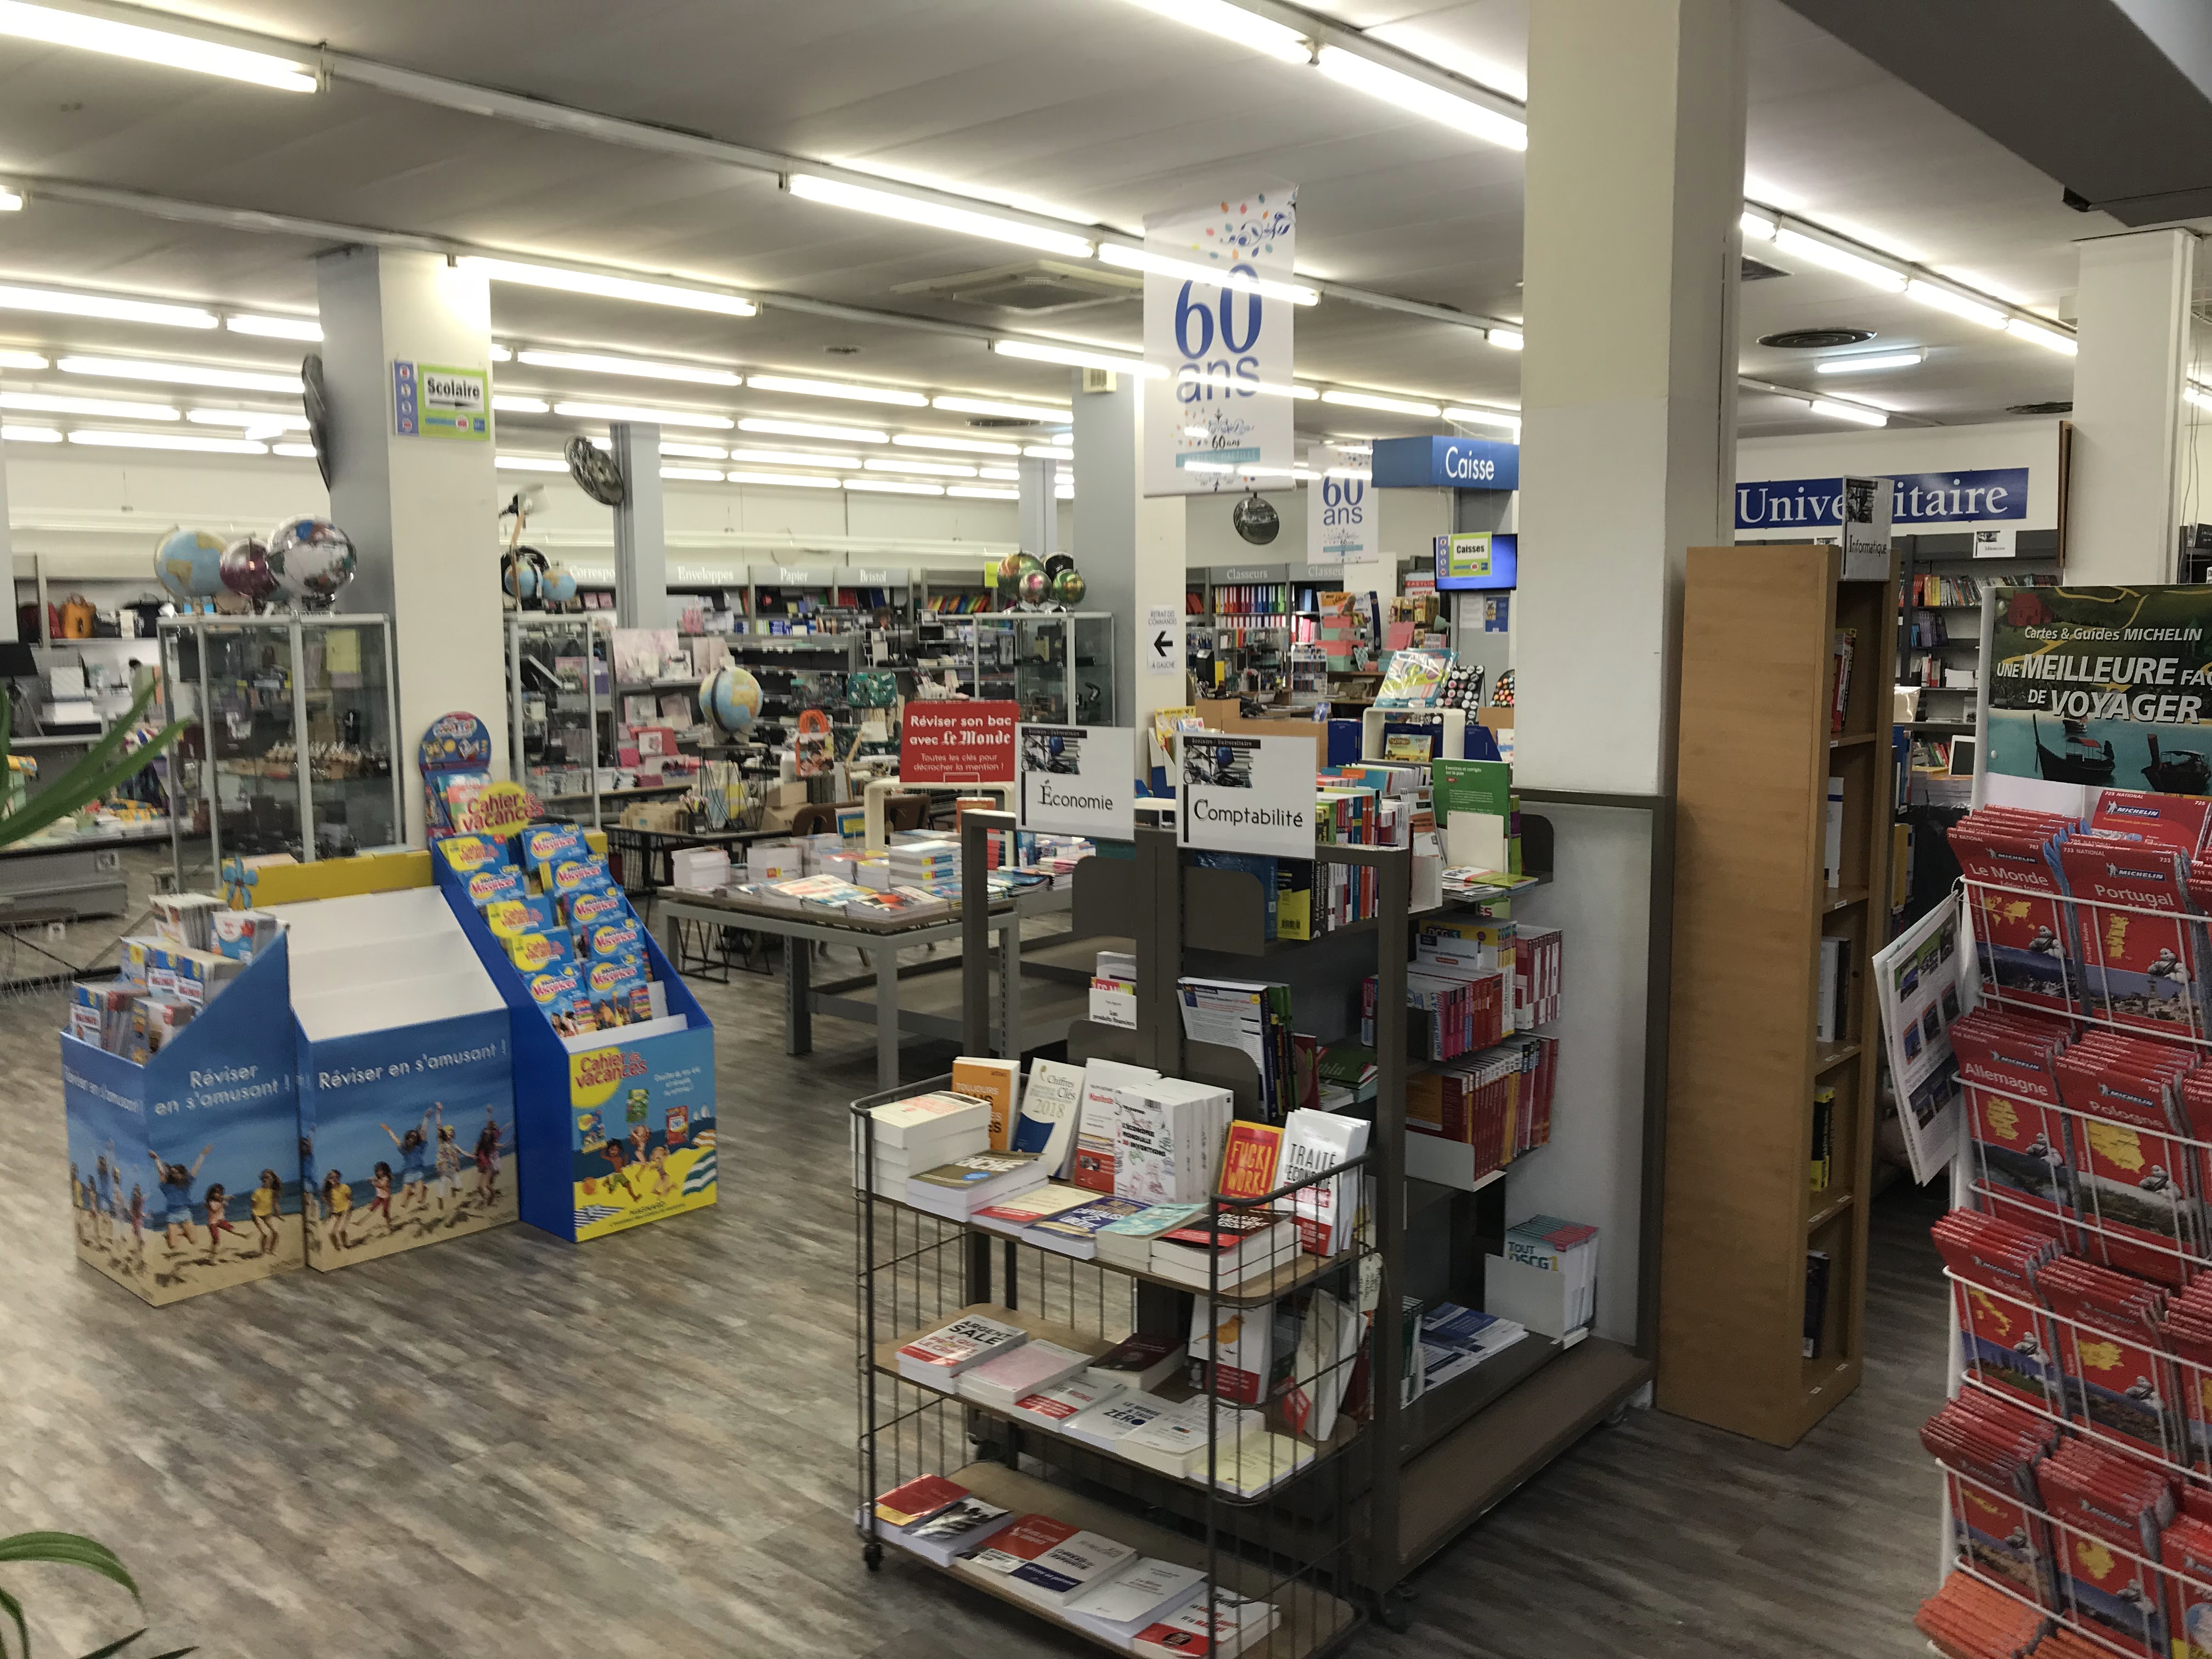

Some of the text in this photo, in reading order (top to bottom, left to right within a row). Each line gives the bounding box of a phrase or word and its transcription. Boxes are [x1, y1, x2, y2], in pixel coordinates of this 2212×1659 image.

[1175, 263, 1262, 359] 60
[427, 377, 480, 400] Scolaire
[1176, 356, 1260, 404] ans
[1212, 435, 1226, 449] 60
[1445, 445, 1495, 481] Caisse
[1323, 476, 1364, 507] 60
[1737, 478, 2008, 523] Univeitaire
[1323, 506, 1363, 526] ans
[1457, 544, 1485, 554] Caisses
[1849, 534, 1887, 557] Informatique
[571, 565, 615, 582] Correspo
[678, 565, 734, 585] Enveloppes
[780, 567, 808, 584] Papier
[859, 568, 887, 584] Bristol
[1227, 568, 1268, 580] Classeurs
[1308, 565, 1344, 578] Classeu
[2024, 627, 2203, 641] Cartes & Guides MICHELIN
[1996, 662, 2021, 679] UNE
[2021, 653, 2179, 686] MEILLEURE
[2028, 689, 2203, 725] DE VOYAGER
[910, 714, 1012, 727] Réviser son bac
[909, 730, 1011, 746] avec Le Monde
[913, 763, 953, 772] décrocher
[955, 763, 963, 771] la
[964, 763, 999, 771] mention
[920, 753, 998, 763] Toutes les clés pour
[467, 792, 536, 815] Cahier de
[1037, 779, 1114, 810] Économie
[462, 800, 545, 832] vacances
[1194, 798, 1304, 827] Comptabilité
[2117, 806, 2159, 817] MICHELIN
[1959, 834, 1984, 843] NATIONAL
[1998, 853, 2036, 863] MICHELIN
[2076, 848, 2106, 857] NATIONAL
[1968, 862, 2050, 887] Le Monde
[2118, 870, 2164, 879] MICHELIN
[2094, 884, 2175, 910] Portugal
[318, 1065, 384, 1091] Réviser
[387, 1060, 411, 1078] en
[414, 1042, 497, 1073] s'amusant
[500, 1037, 507, 1056] !
[579, 1051, 625, 1073] Cahier
[2000, 1056, 2040, 1070] MICHELIN
[189, 1064, 259, 1090] Réviser
[575, 1058, 649, 1089] vacances
[1046, 1074, 1075, 1088] Chiffres
[1965, 1062, 2049, 1096] Allemagne
[154, 1098, 180, 1116] en
[185, 1079, 279, 1111] s'amusant
[284, 1074, 290, 1092] !
[955, 1081, 1000, 1096] TOUJOURS
[1057, 1087, 1076, 1101] Clés
[2111, 1090, 2153, 1107] MICHELIN
[1032, 1098, 1066, 1119] 2018
[2089, 1100, 2165, 1128] Pologne
[955, 1155, 1029, 1172] RICHE
[1508, 1240, 1537, 1255] TOUT
[948, 1324, 1004, 1345] SALE
[960, 1321, 1014, 1339] ARGENT
